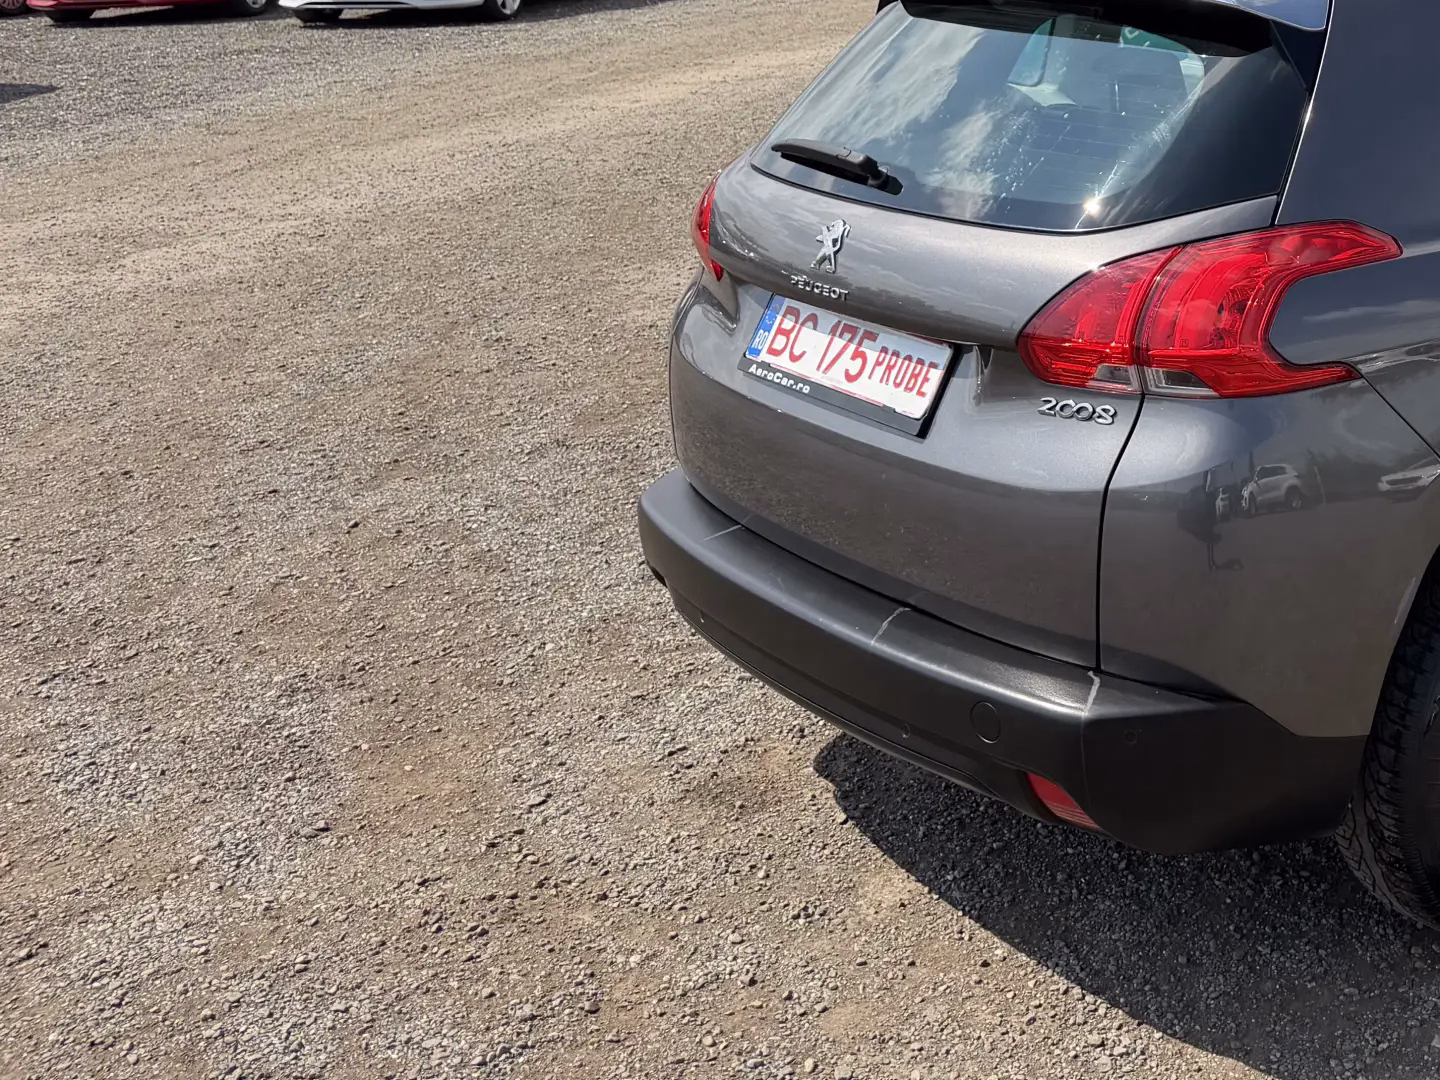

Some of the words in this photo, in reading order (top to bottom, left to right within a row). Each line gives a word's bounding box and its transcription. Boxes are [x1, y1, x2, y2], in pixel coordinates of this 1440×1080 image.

[790, 275, 849, 301] PEUGEOT
[753, 329, 769, 350] RO
[766, 305, 818, 363] BC
[816, 320, 880, 384] 175
[868, 346, 940, 398] PROBE
[748, 364, 810, 394] AeroCar.ro
[1037, 397, 1116, 425] 2008
